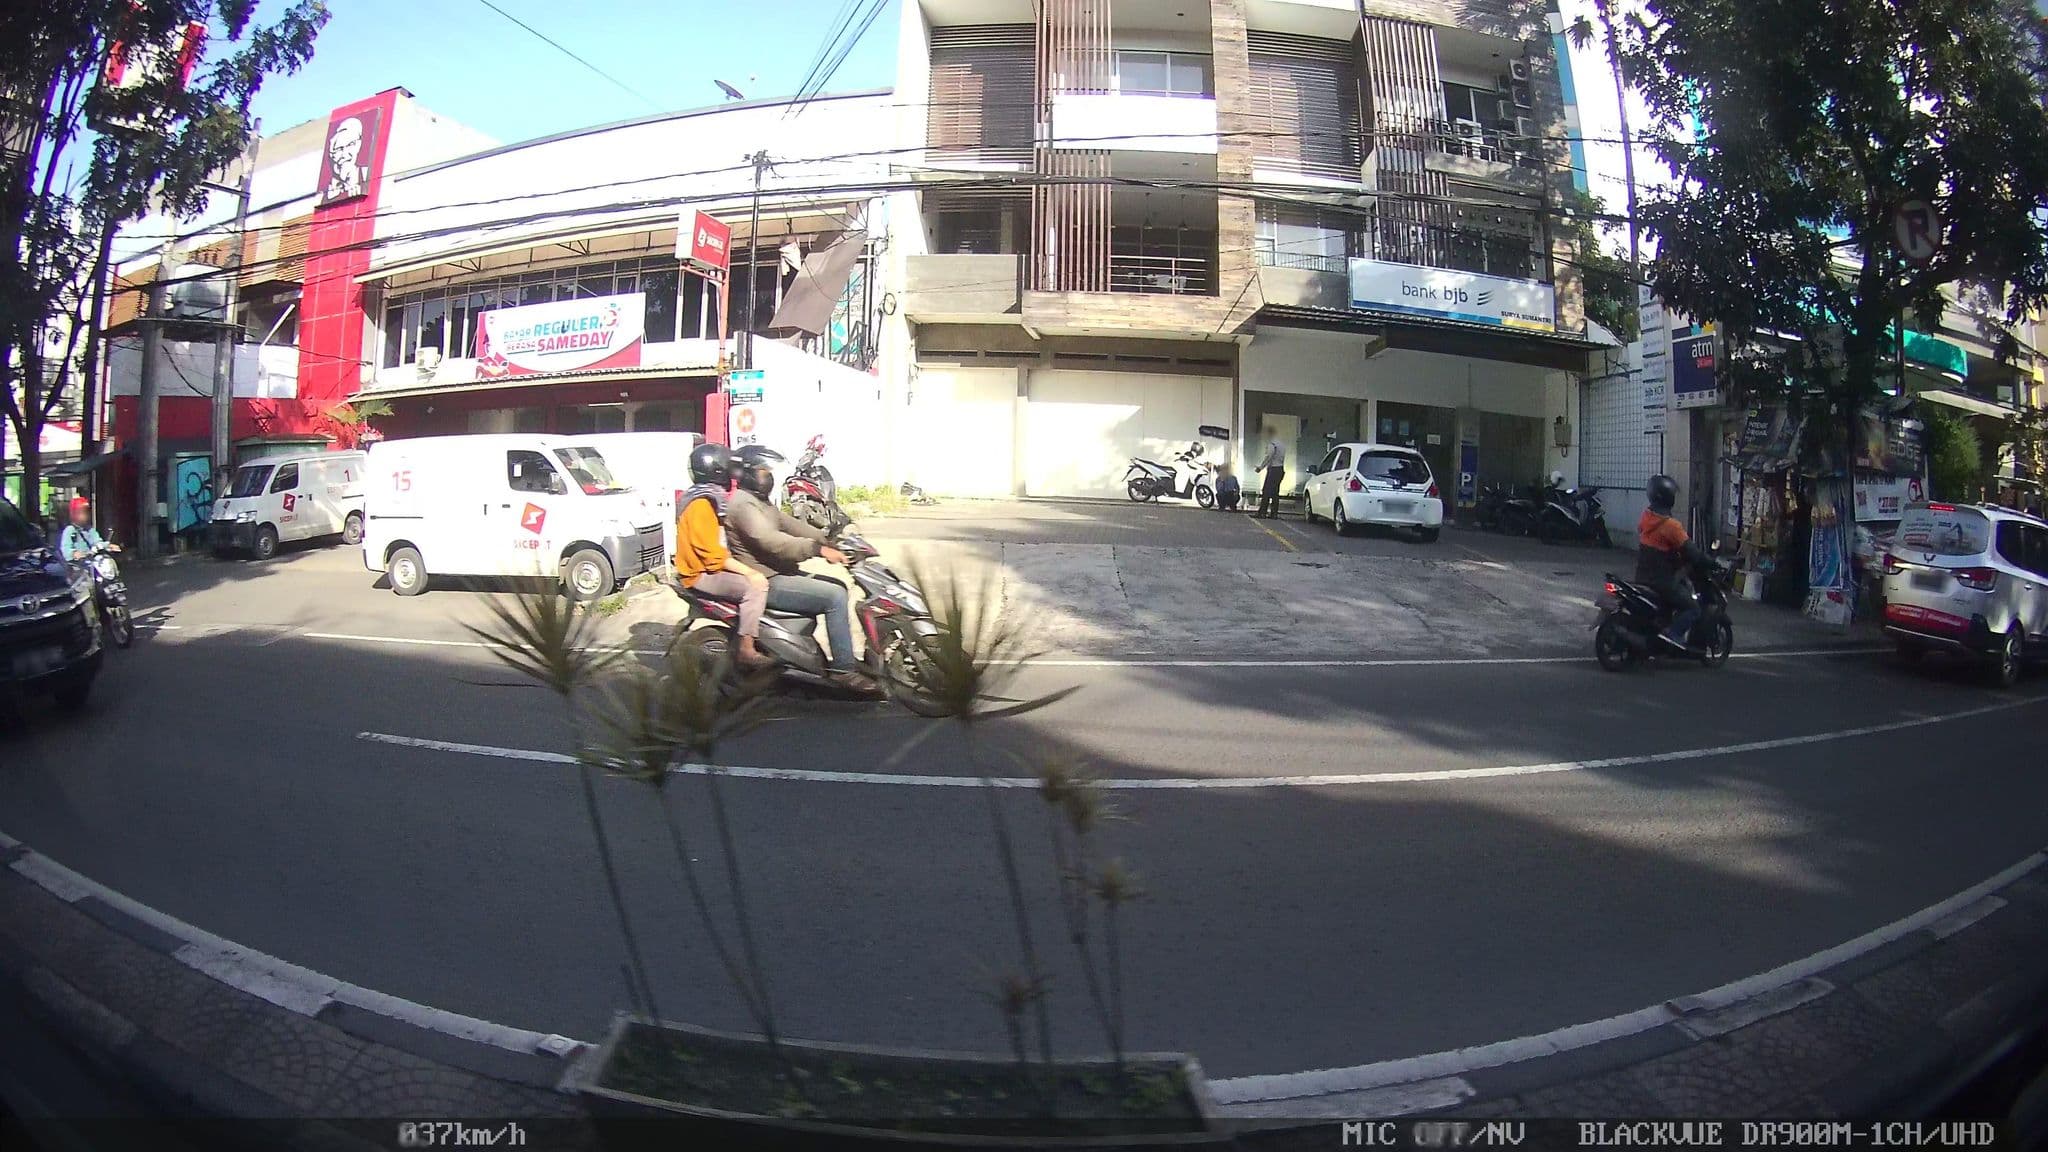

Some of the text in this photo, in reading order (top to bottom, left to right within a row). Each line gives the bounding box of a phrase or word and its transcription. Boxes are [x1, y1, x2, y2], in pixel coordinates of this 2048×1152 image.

[1401, 281, 1468, 305] bank bjb
[1501, 310, 1521, 320] SURYA
[537, 331, 610, 352] SAMEDAY
[1691, 341, 1713, 358] atm
[391, 470, 412, 492] 15
[1462, 475, 1472, 486] P
